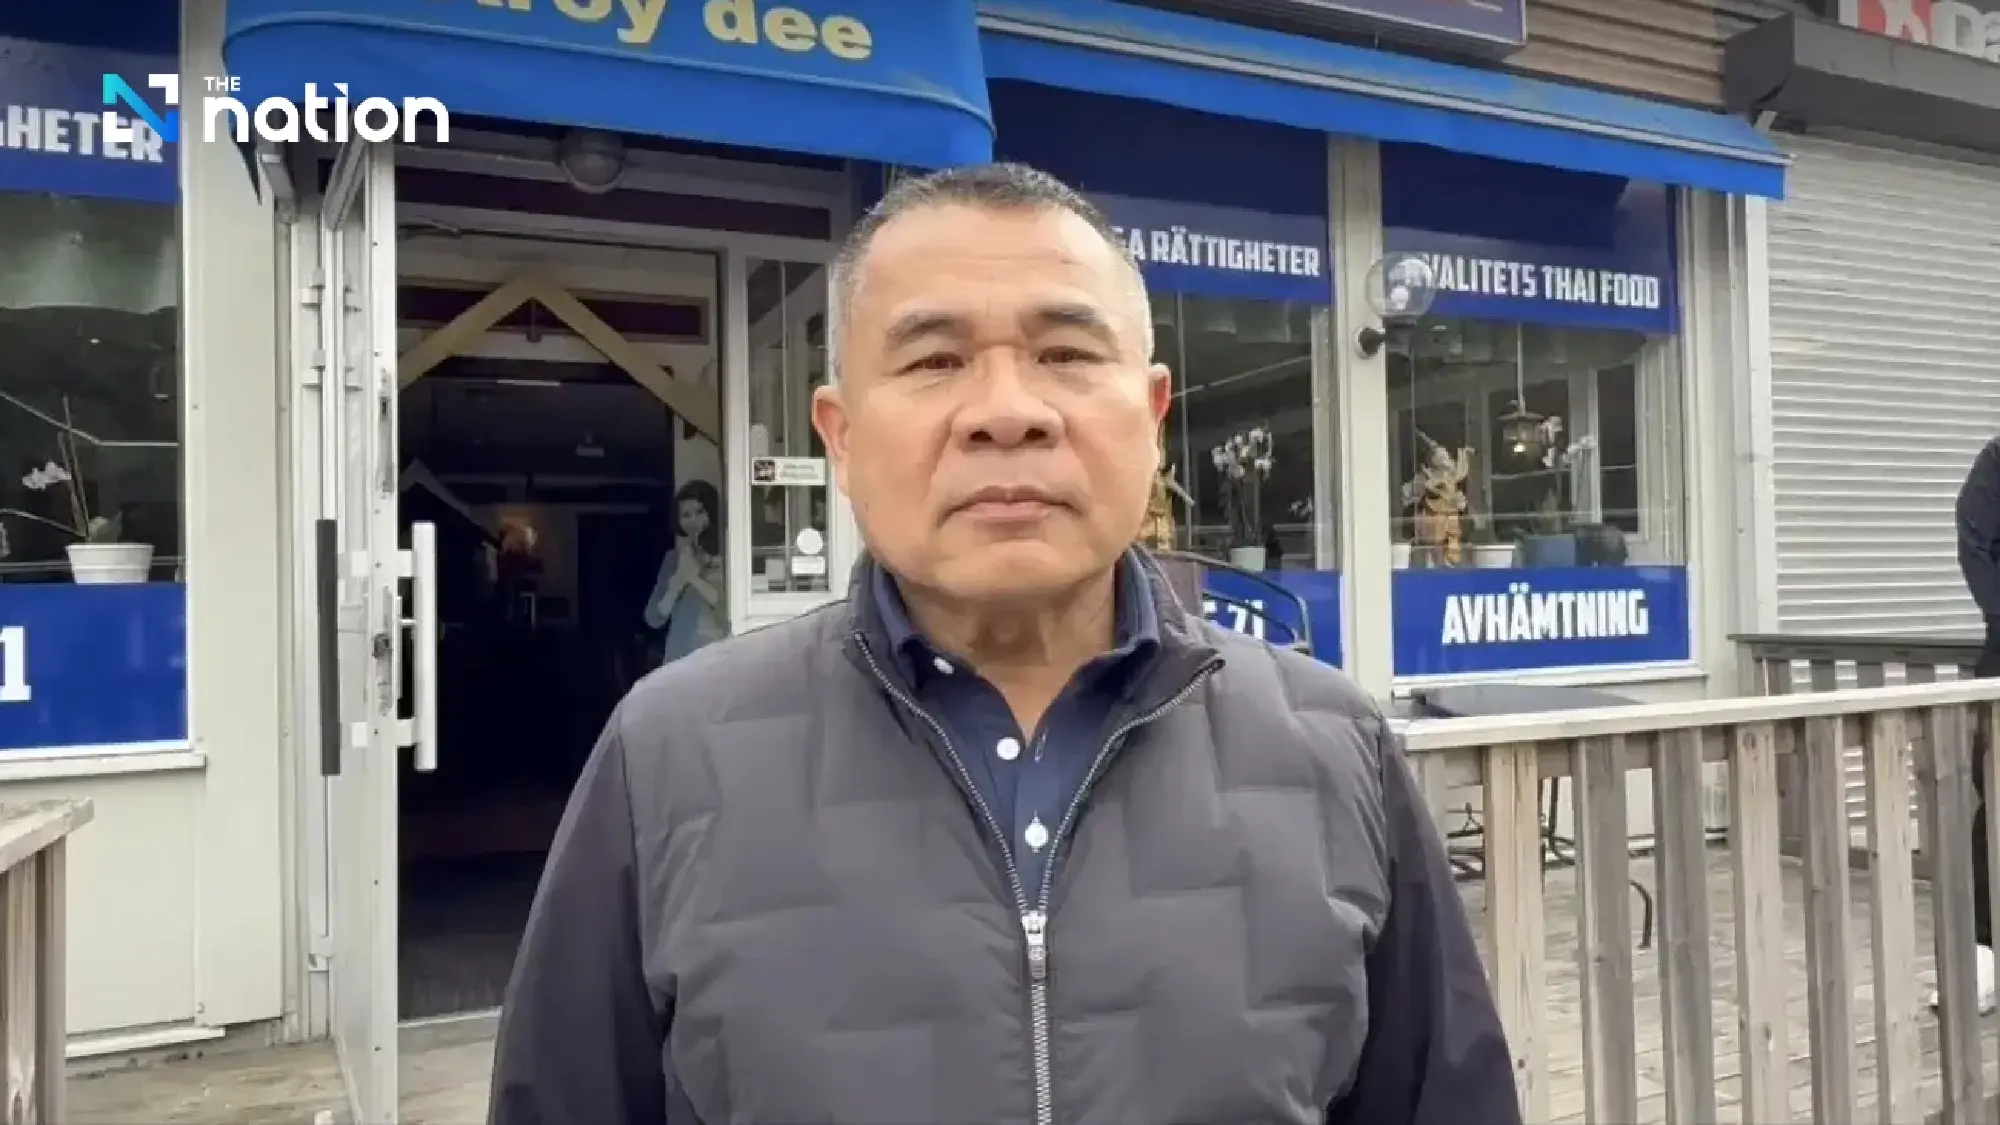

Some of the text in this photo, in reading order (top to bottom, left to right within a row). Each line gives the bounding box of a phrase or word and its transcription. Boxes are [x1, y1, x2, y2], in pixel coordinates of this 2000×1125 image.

[703, 0, 872, 60] dee
[0, 105, 163, 163] HETER
[1151, 225, 1321, 277] RÄTTIGHETER
[1542, 264, 1596, 303] THAI
[1600, 270, 1660, 309] FOOD
[1442, 582, 1649, 644] AVHÄMTNING
